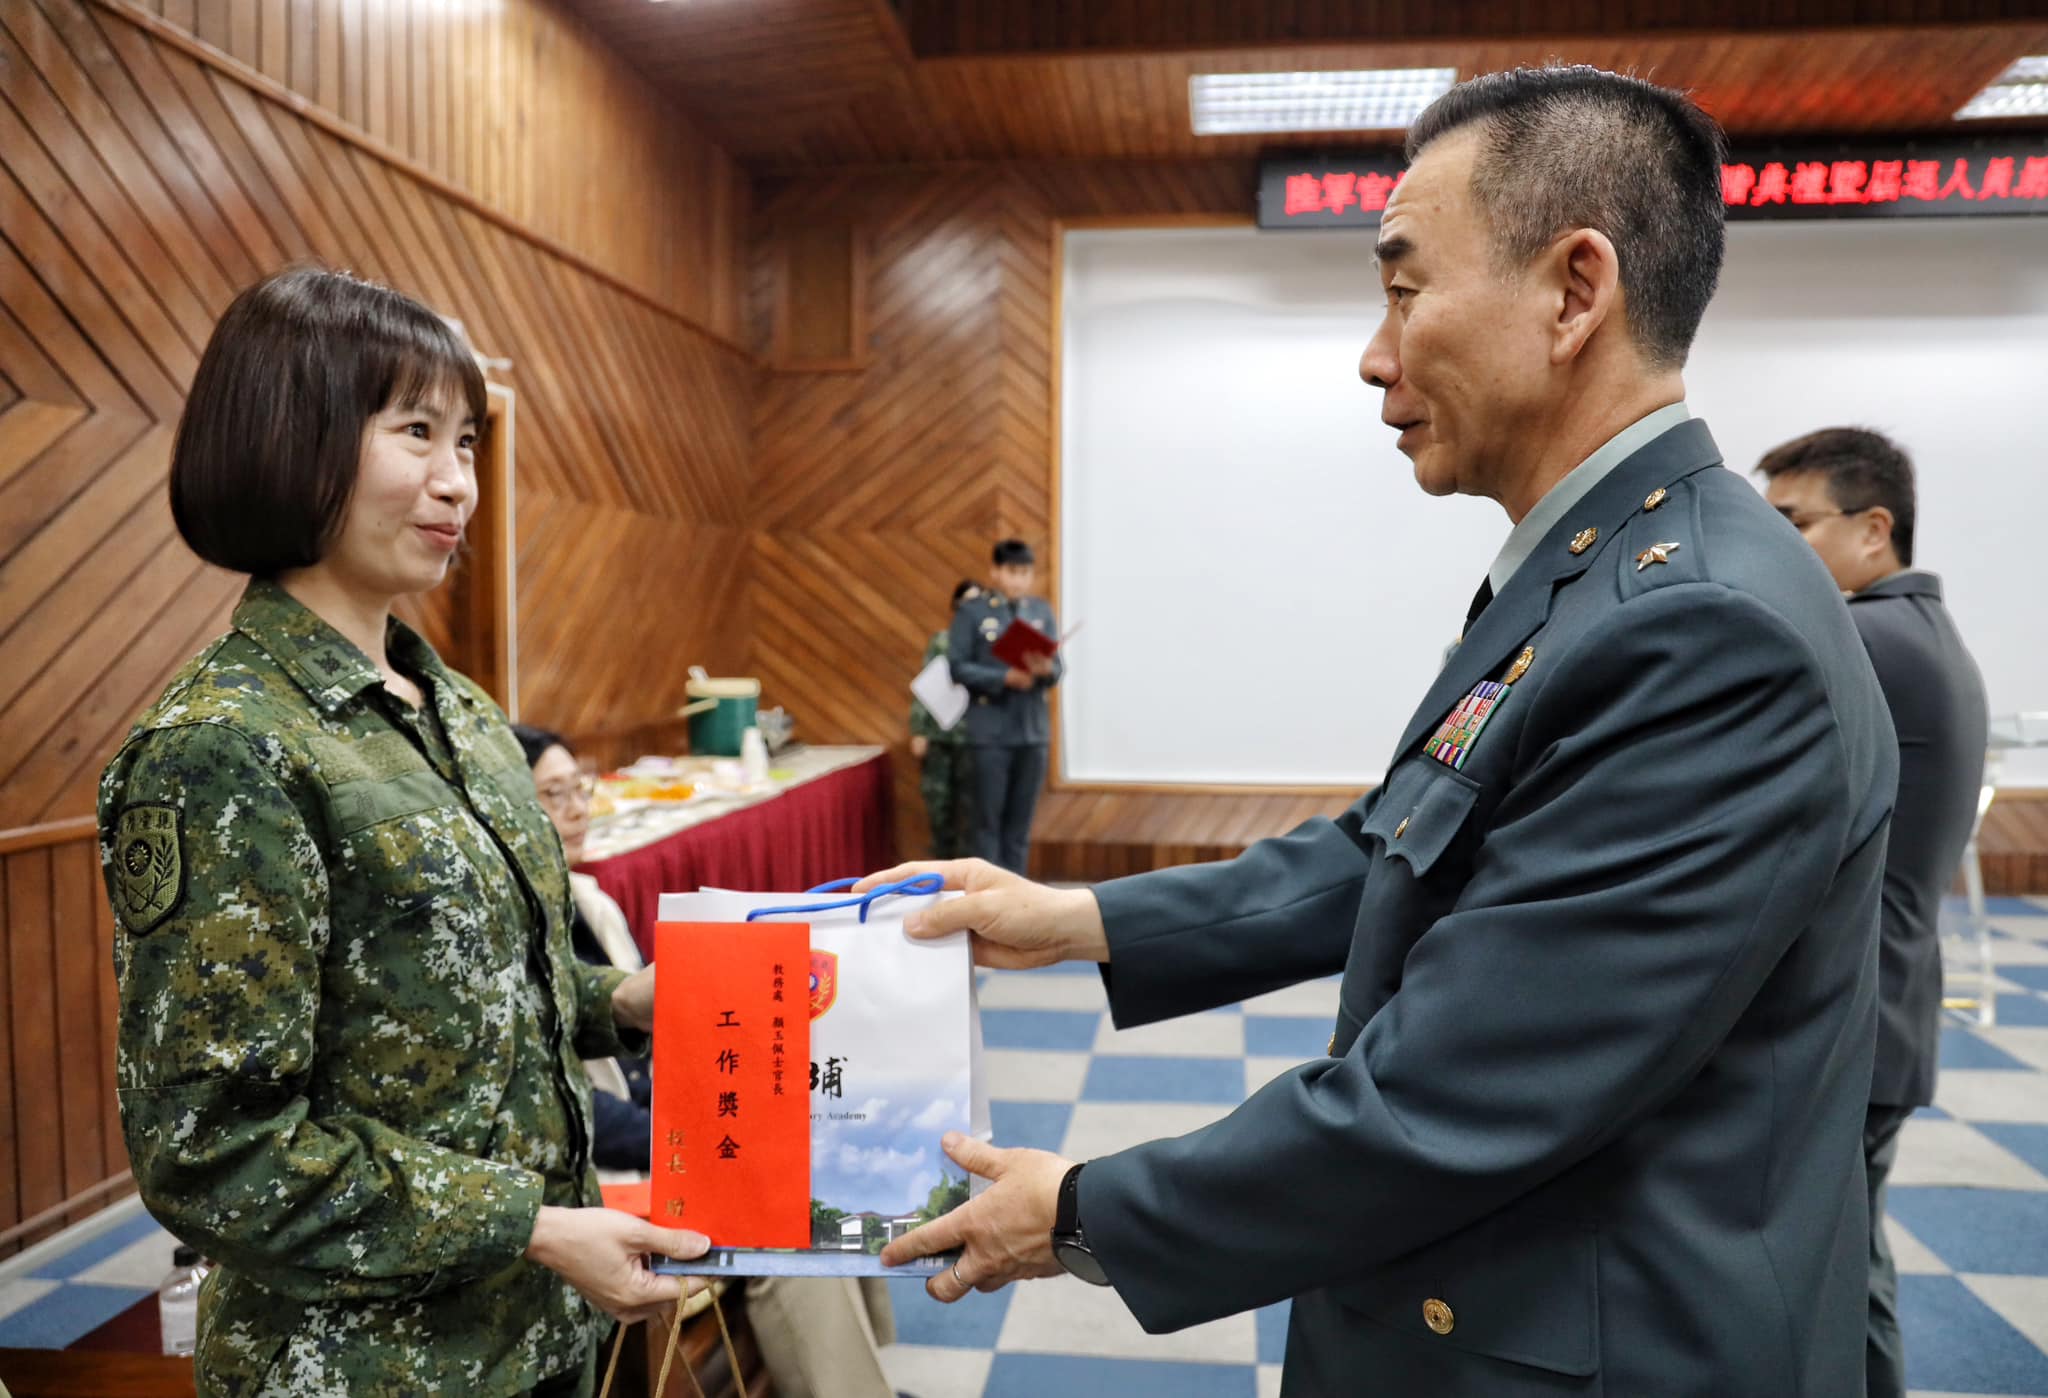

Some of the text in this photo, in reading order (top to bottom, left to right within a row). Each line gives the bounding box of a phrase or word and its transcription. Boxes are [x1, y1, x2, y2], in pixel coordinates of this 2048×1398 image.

[1285, 171, 1405, 216] 陸軍官
[715, 1010, 741, 1160] 工作獎金
[827, 1112, 867, 1121] Academy
